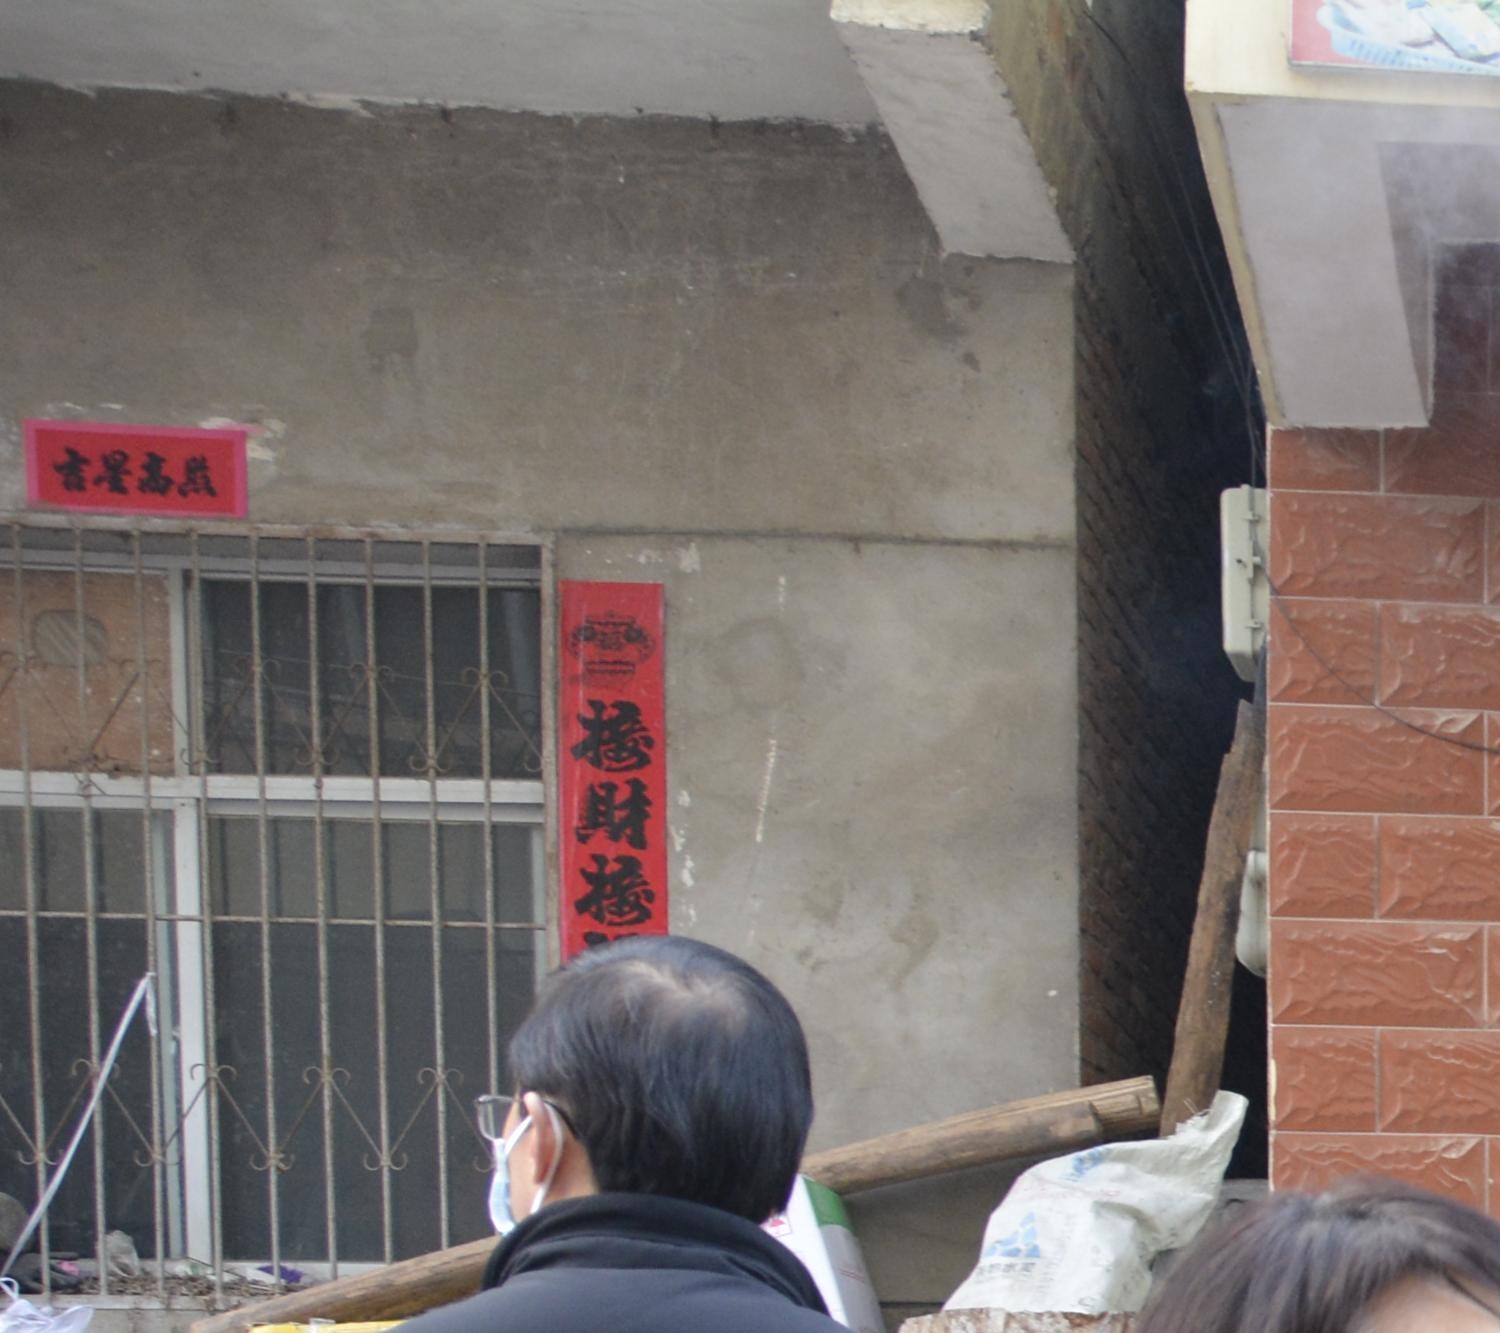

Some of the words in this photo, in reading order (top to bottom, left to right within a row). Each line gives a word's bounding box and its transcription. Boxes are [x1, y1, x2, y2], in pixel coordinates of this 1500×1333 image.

[53, 446, 217, 498] 吉星高照
[570, 699, 656, 952] 接財接
